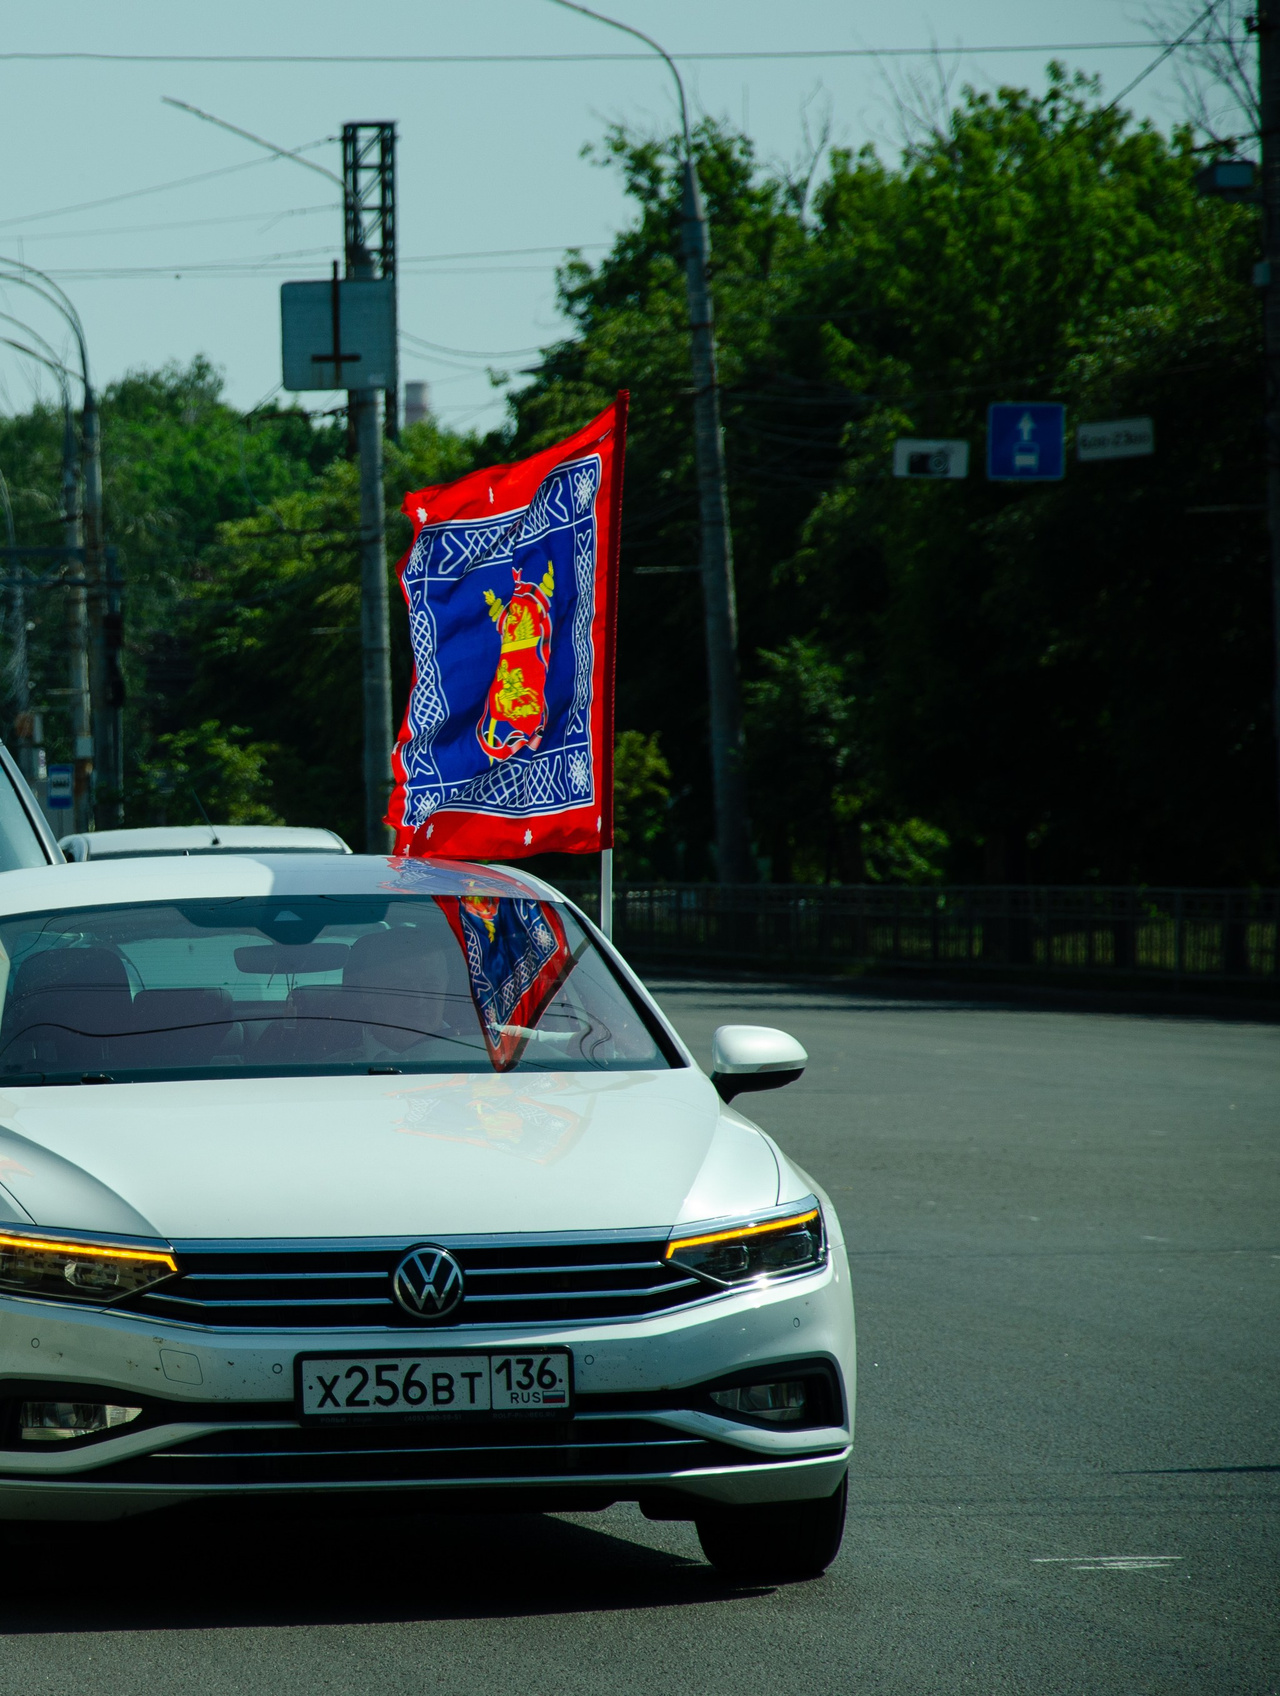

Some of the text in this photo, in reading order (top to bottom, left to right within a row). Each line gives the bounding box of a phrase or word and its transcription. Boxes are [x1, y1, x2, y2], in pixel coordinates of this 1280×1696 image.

[316, 1357, 557, 1408] X256BT 136
[510, 1392, 541, 1404] RUS
